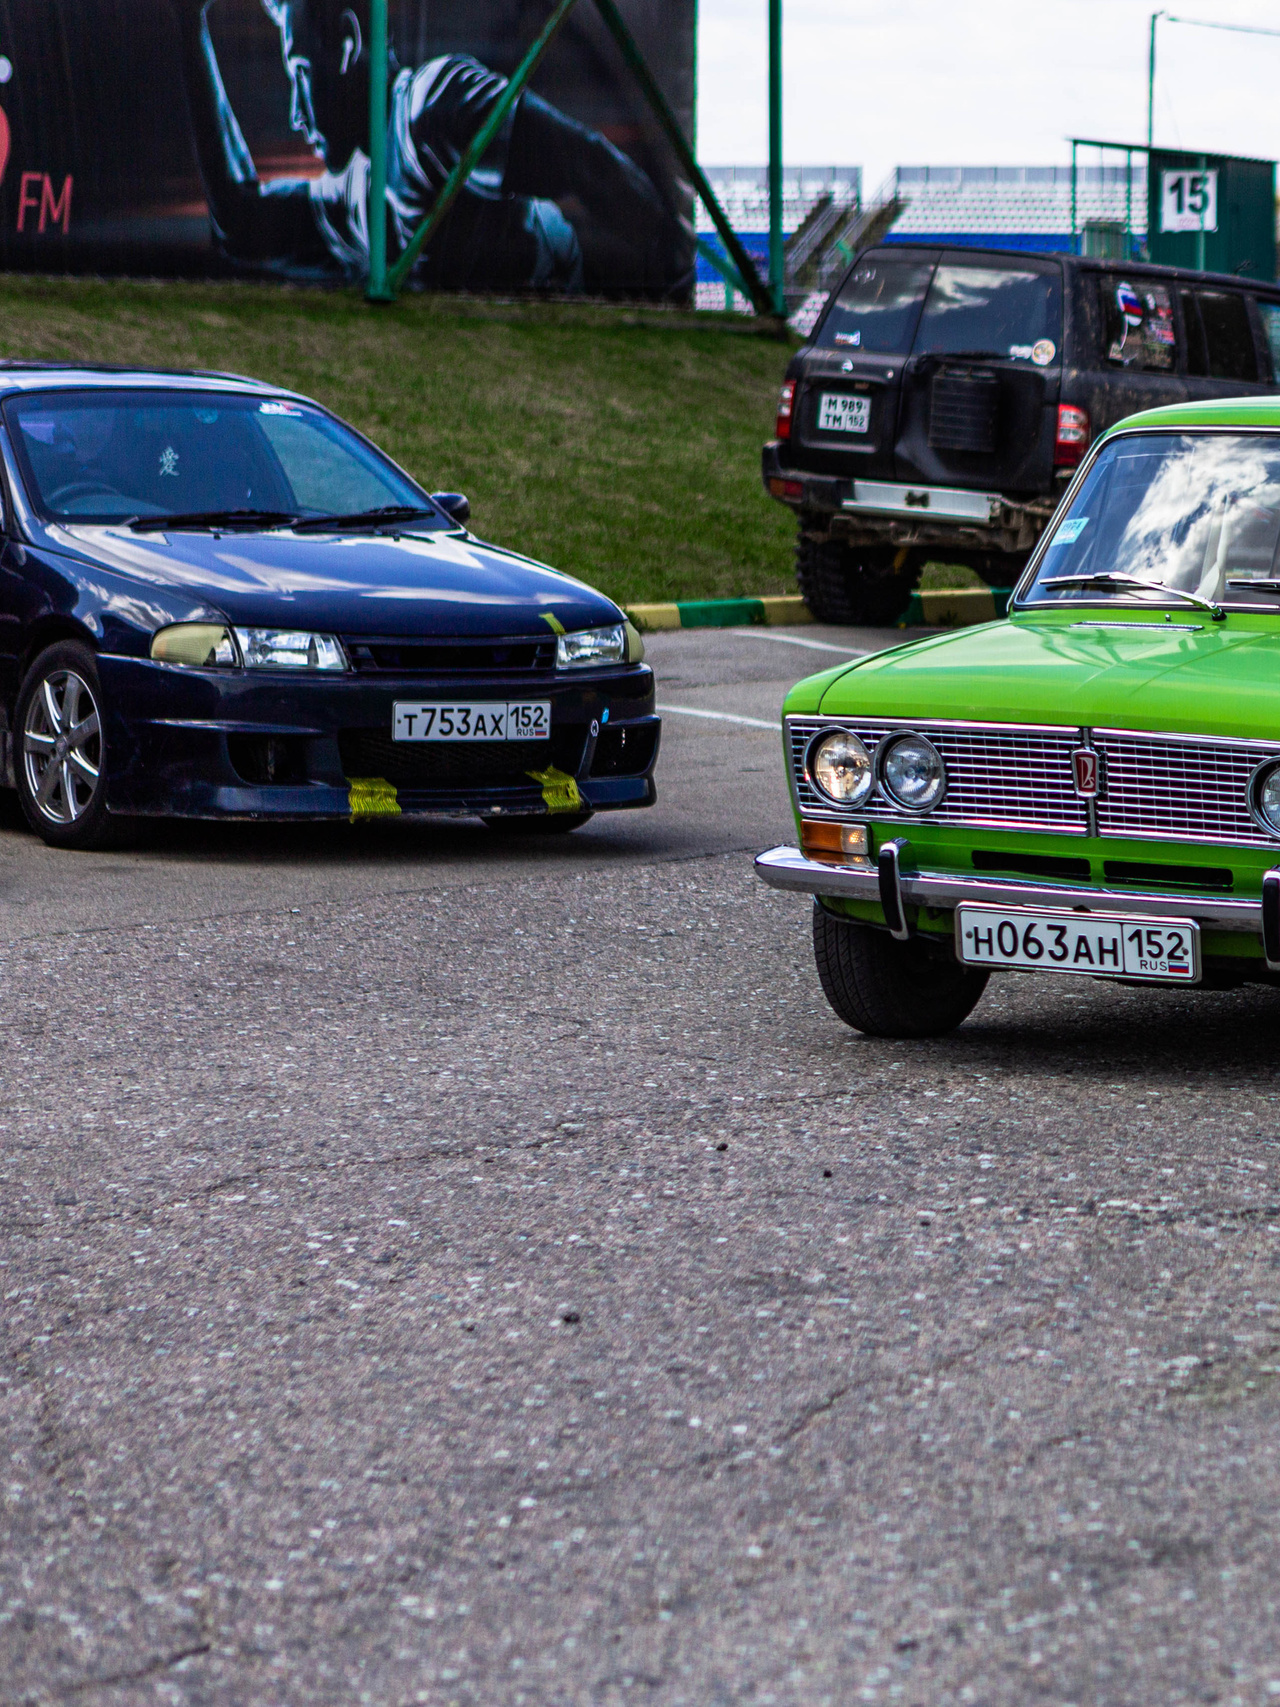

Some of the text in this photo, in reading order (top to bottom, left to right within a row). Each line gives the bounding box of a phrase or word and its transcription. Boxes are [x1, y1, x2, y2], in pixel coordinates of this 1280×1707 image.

[17, 171, 73, 233] FM
[1169, 176, 1209, 214] 15
[403, 706, 544, 736] Т753АХ 152
[516, 728, 534, 736] RUS
[973, 920, 1184, 967] Н063АН 152
[1139, 959, 1167, 972] RUS
